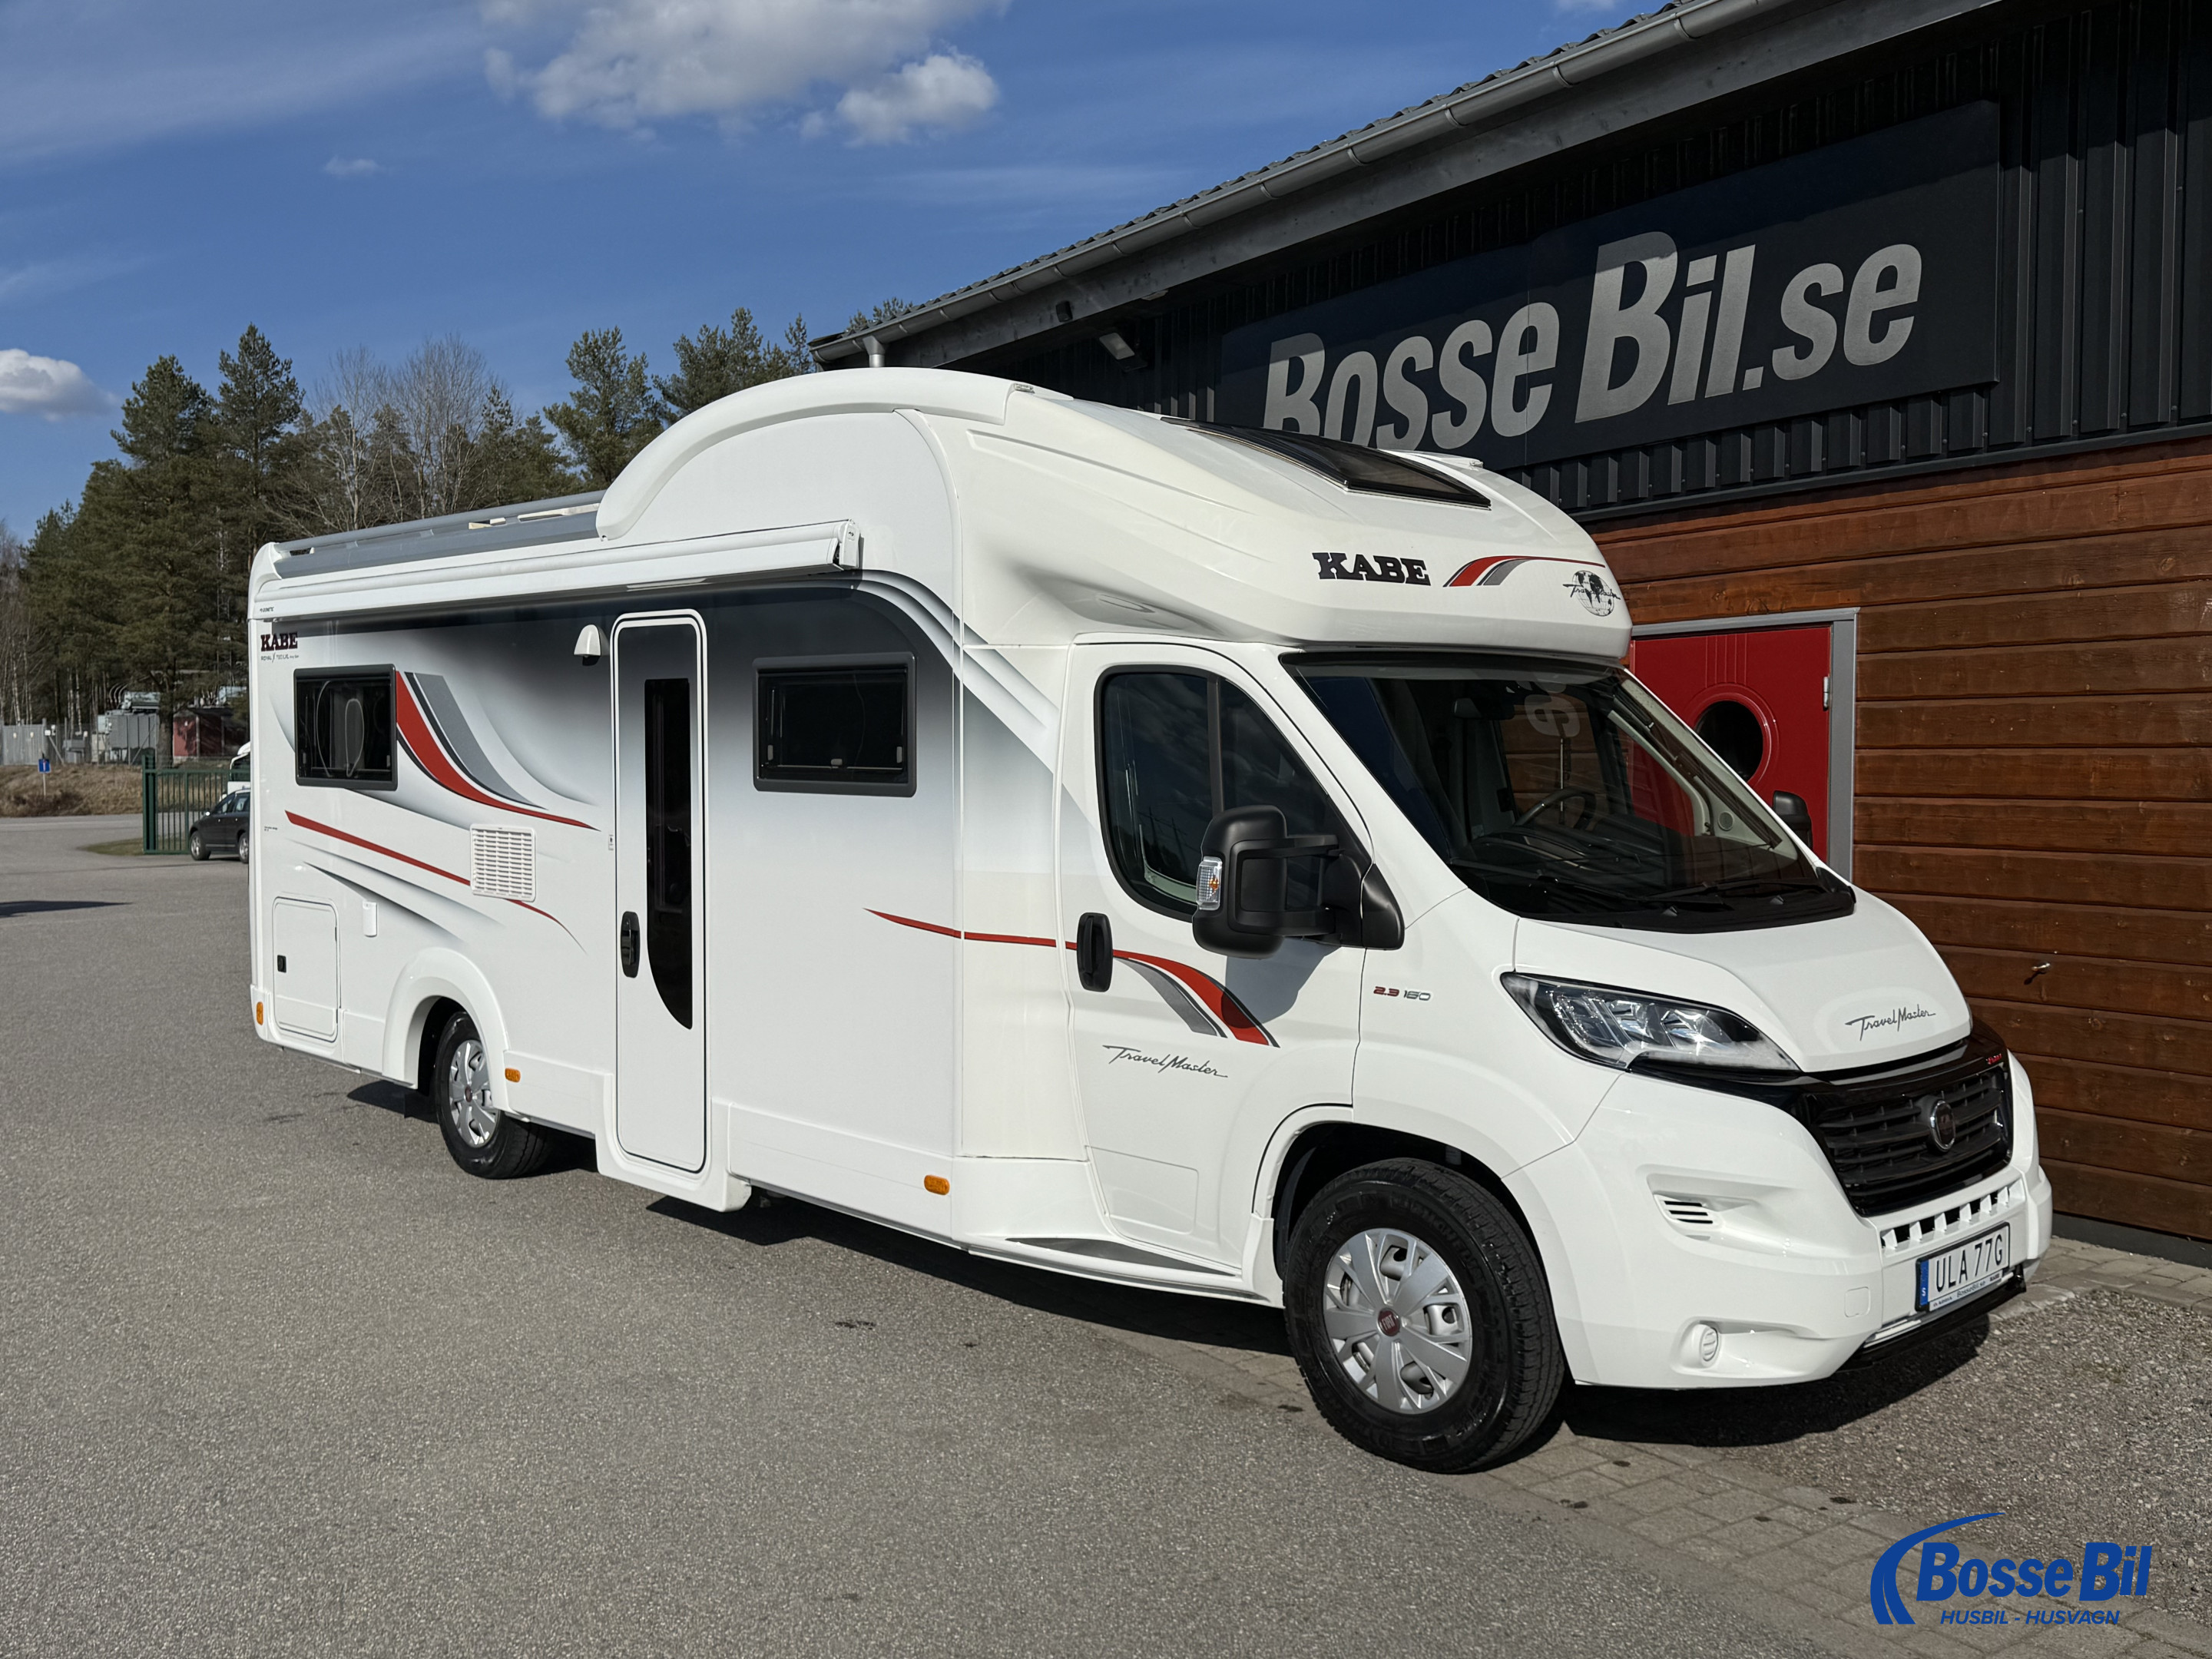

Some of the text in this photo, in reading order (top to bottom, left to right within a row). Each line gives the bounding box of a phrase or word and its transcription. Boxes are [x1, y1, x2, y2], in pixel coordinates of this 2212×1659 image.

[1263, 231, 1922, 451] Bosse Bil.se
[1312, 552, 1431, 586] KABE
[260, 631, 298, 652] KABE
[1373, 986, 1399, 997] 2.3
[1936, 1233, 2002, 1293] ULA 77G
[1922, 1287, 1926, 1296] S
[1381, 1313, 1396, 1330] FIAT
